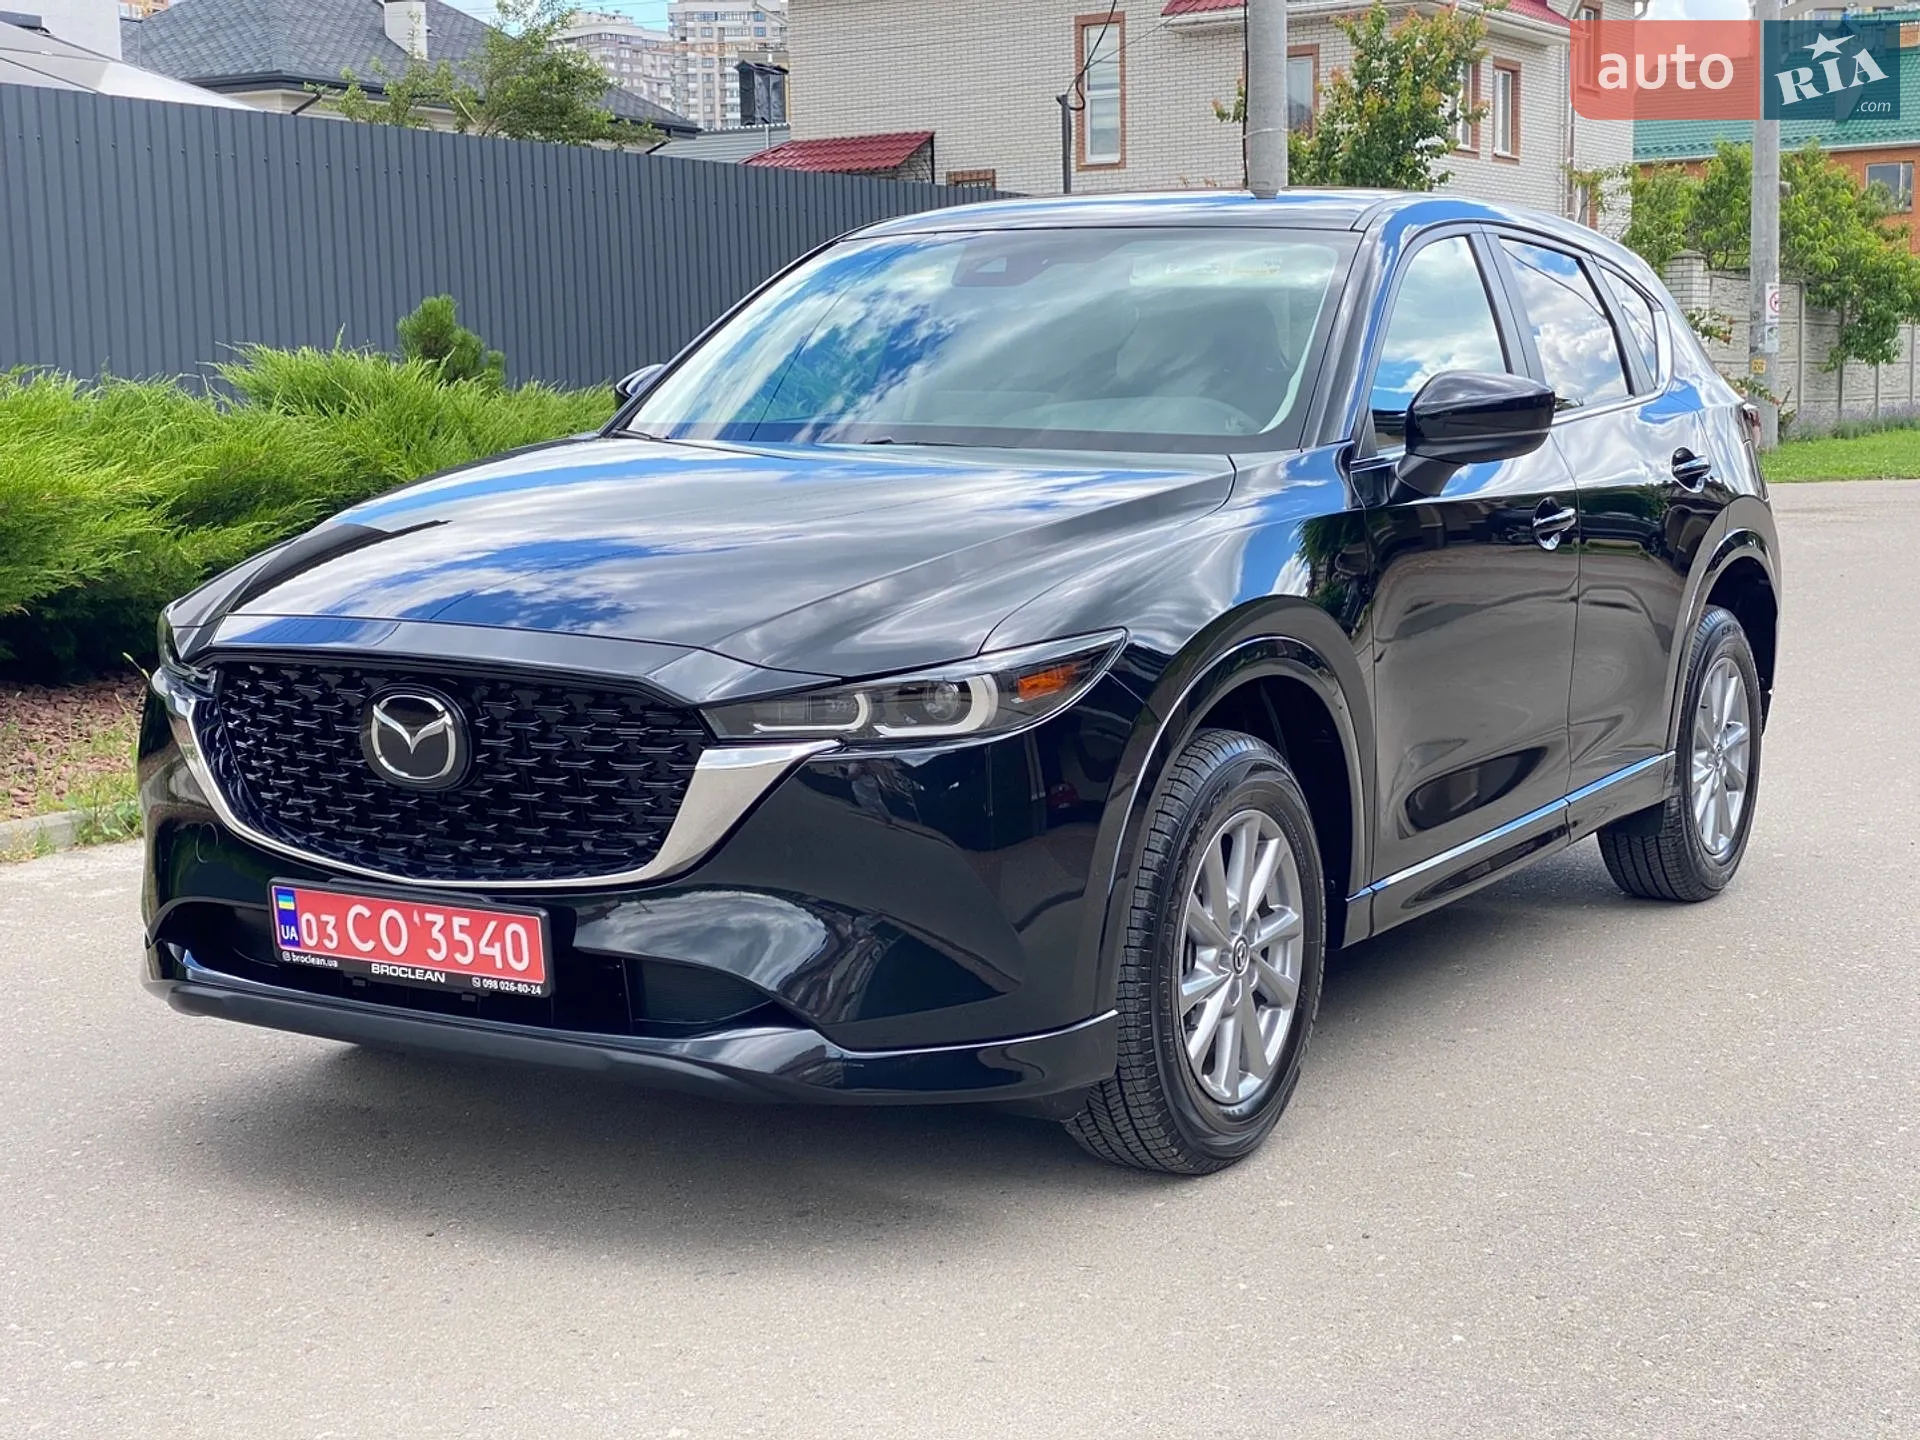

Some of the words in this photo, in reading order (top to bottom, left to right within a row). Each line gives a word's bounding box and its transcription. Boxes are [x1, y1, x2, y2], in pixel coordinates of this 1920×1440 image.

[281, 924, 299, 941] UA
[301, 911, 338, 950] 03
[424, 912, 530, 972] 3540
[291, 951, 338, 968] broclean.ua
[371, 963, 446, 983] BROCLEAN
[482, 978, 499, 990] 098
